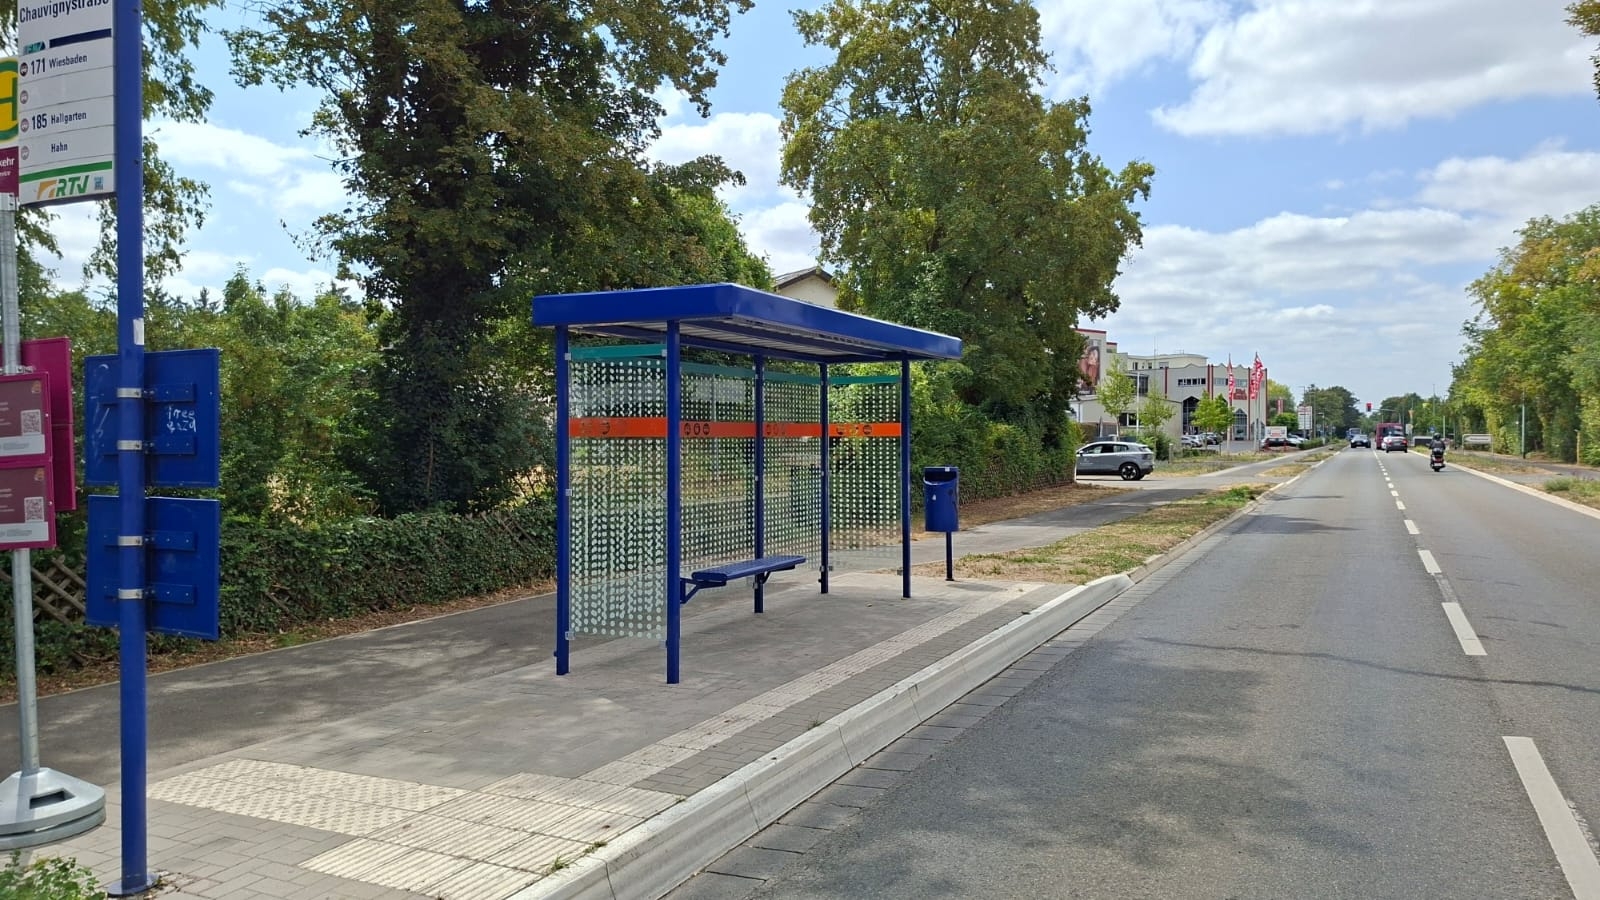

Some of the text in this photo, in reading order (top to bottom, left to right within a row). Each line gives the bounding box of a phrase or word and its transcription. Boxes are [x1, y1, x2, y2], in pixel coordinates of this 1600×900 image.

[30, 54, 88, 75] 171 Wiesbaden
[31, 112, 87, 130] 185 Hallgarten
[50, 141, 68, 153] Hahn
[56, 175, 90, 197] RTV
